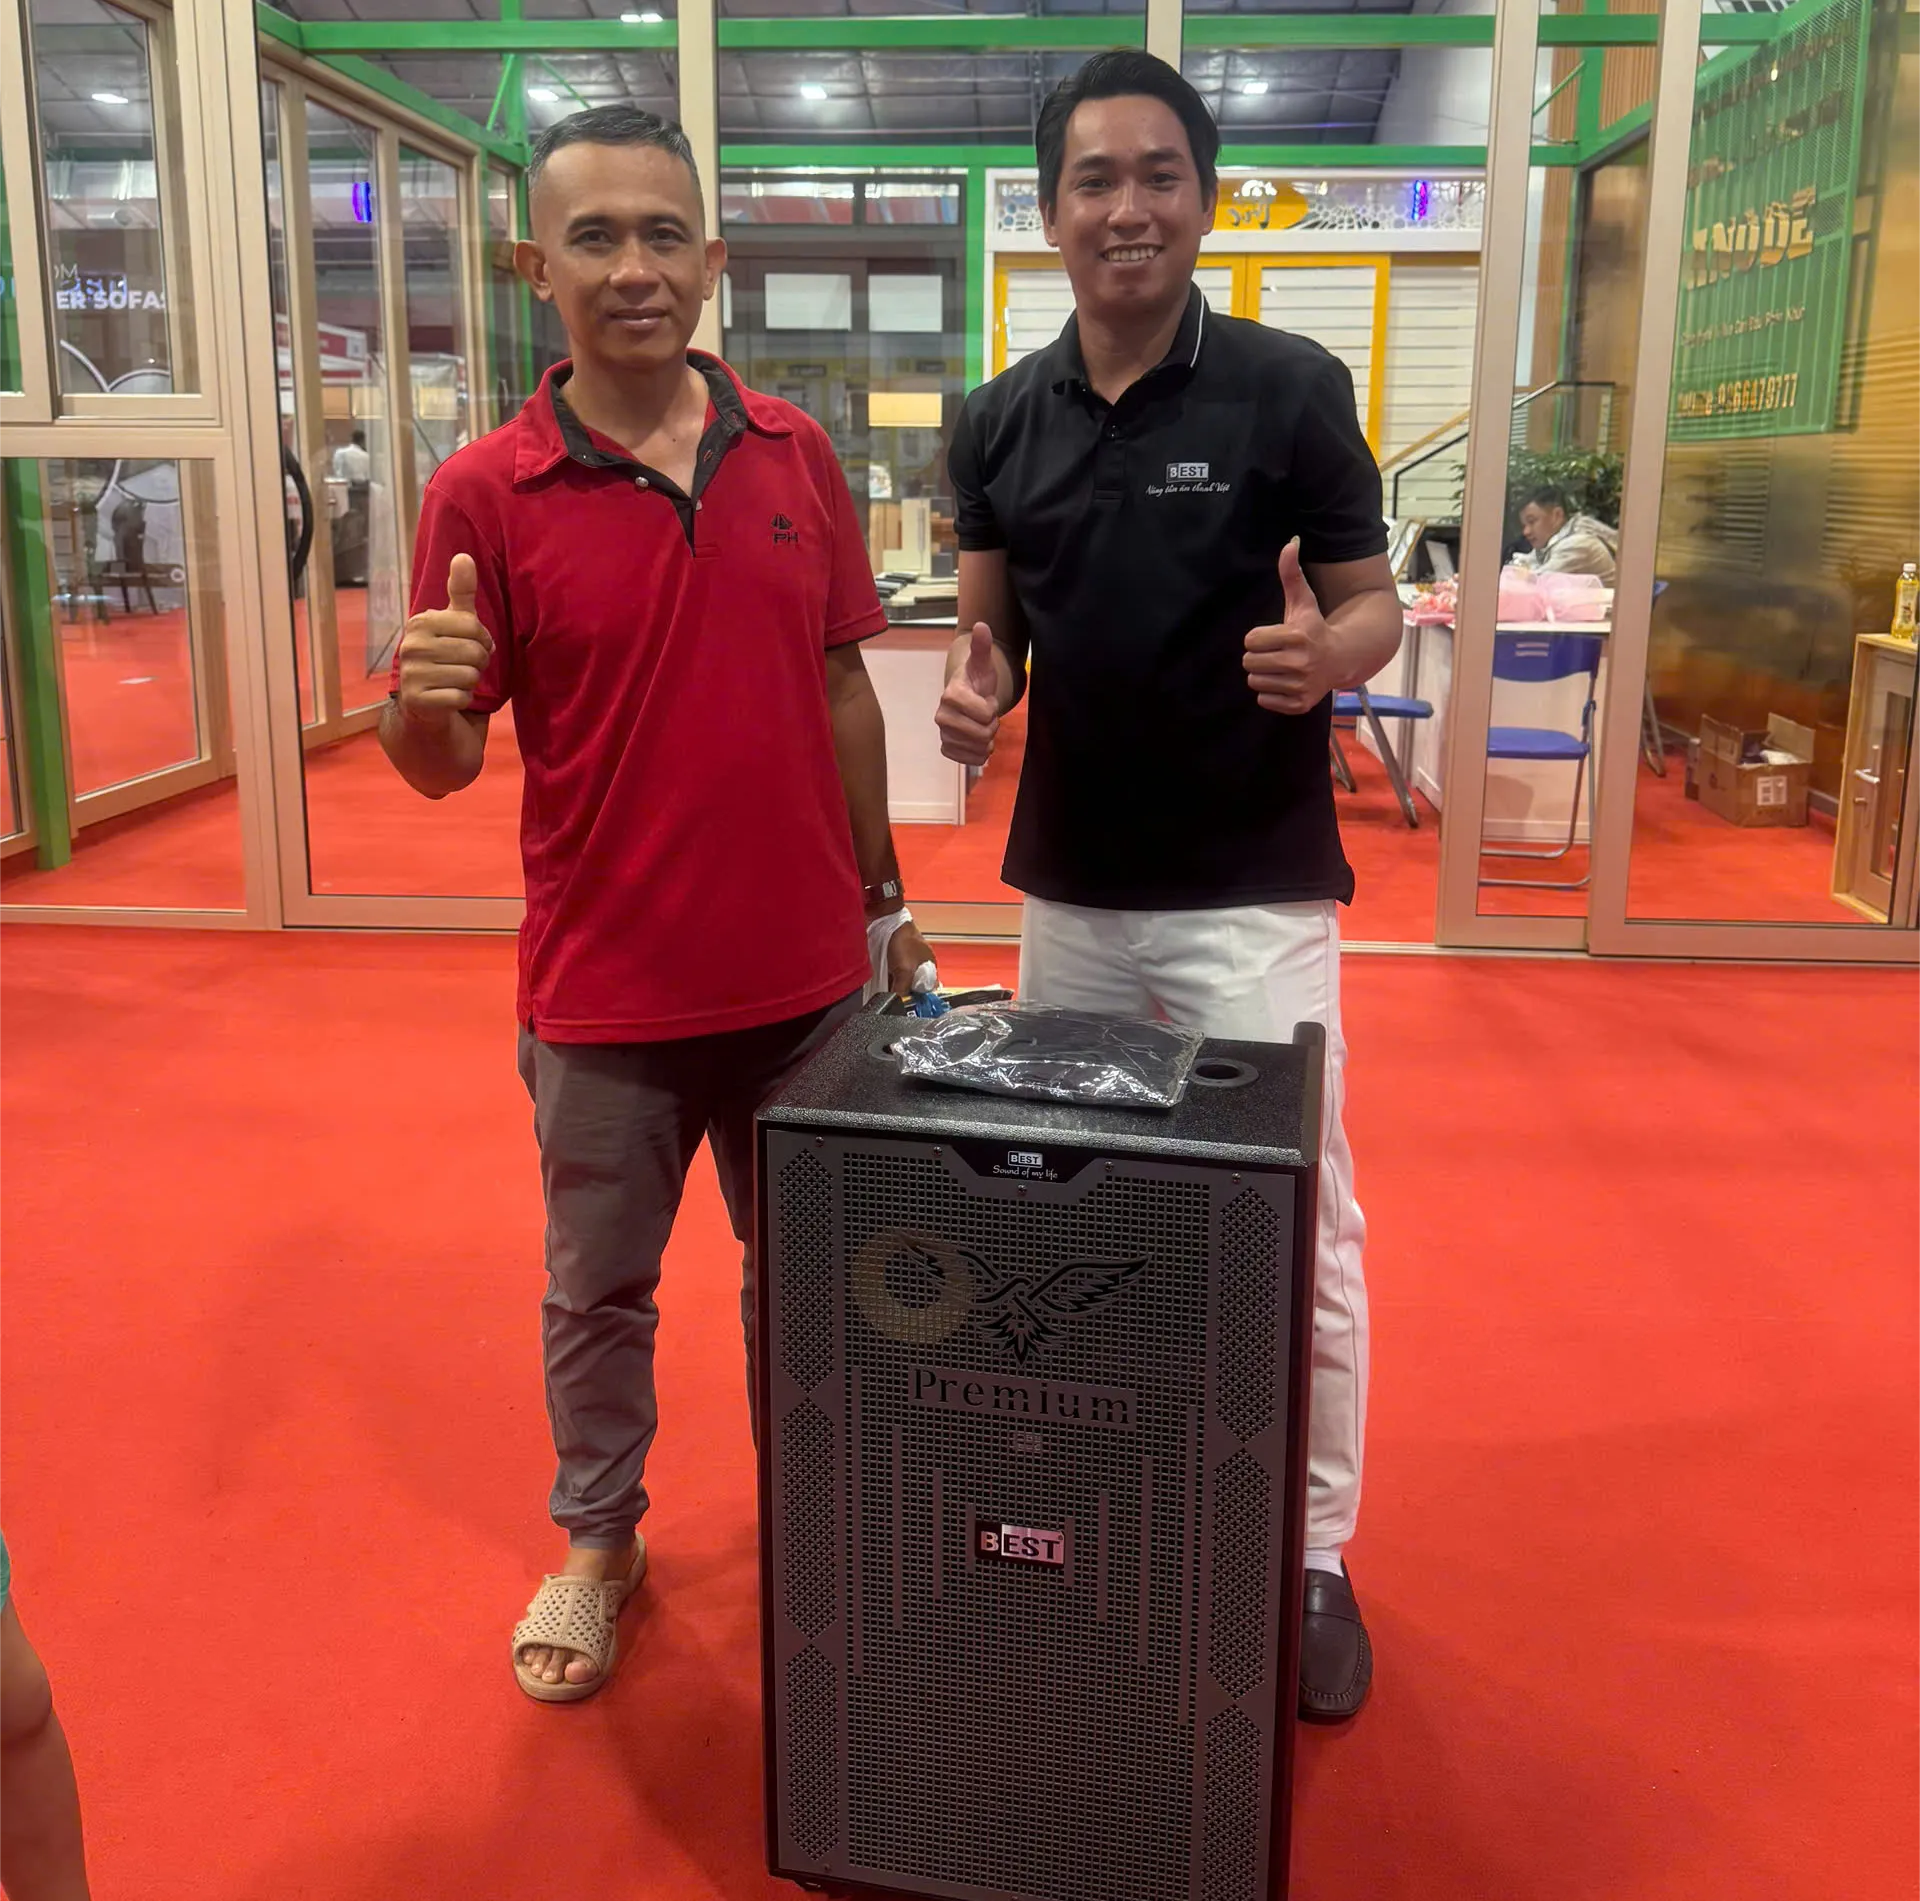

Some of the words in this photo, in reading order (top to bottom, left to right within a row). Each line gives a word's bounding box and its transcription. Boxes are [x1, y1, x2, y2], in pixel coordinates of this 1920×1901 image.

[1169, 465, 1207, 479] BEST
[1010, 1153, 1041, 1165] BEST
[993, 1164, 1020, 1175] Sound
[1021, 1166, 1030, 1178] of
[1032, 1171, 1044, 1179] my
[1045, 1168, 1059, 1180] life
[913, 1368, 1130, 1425] Premium
[980, 1529, 1061, 1561] BEST
